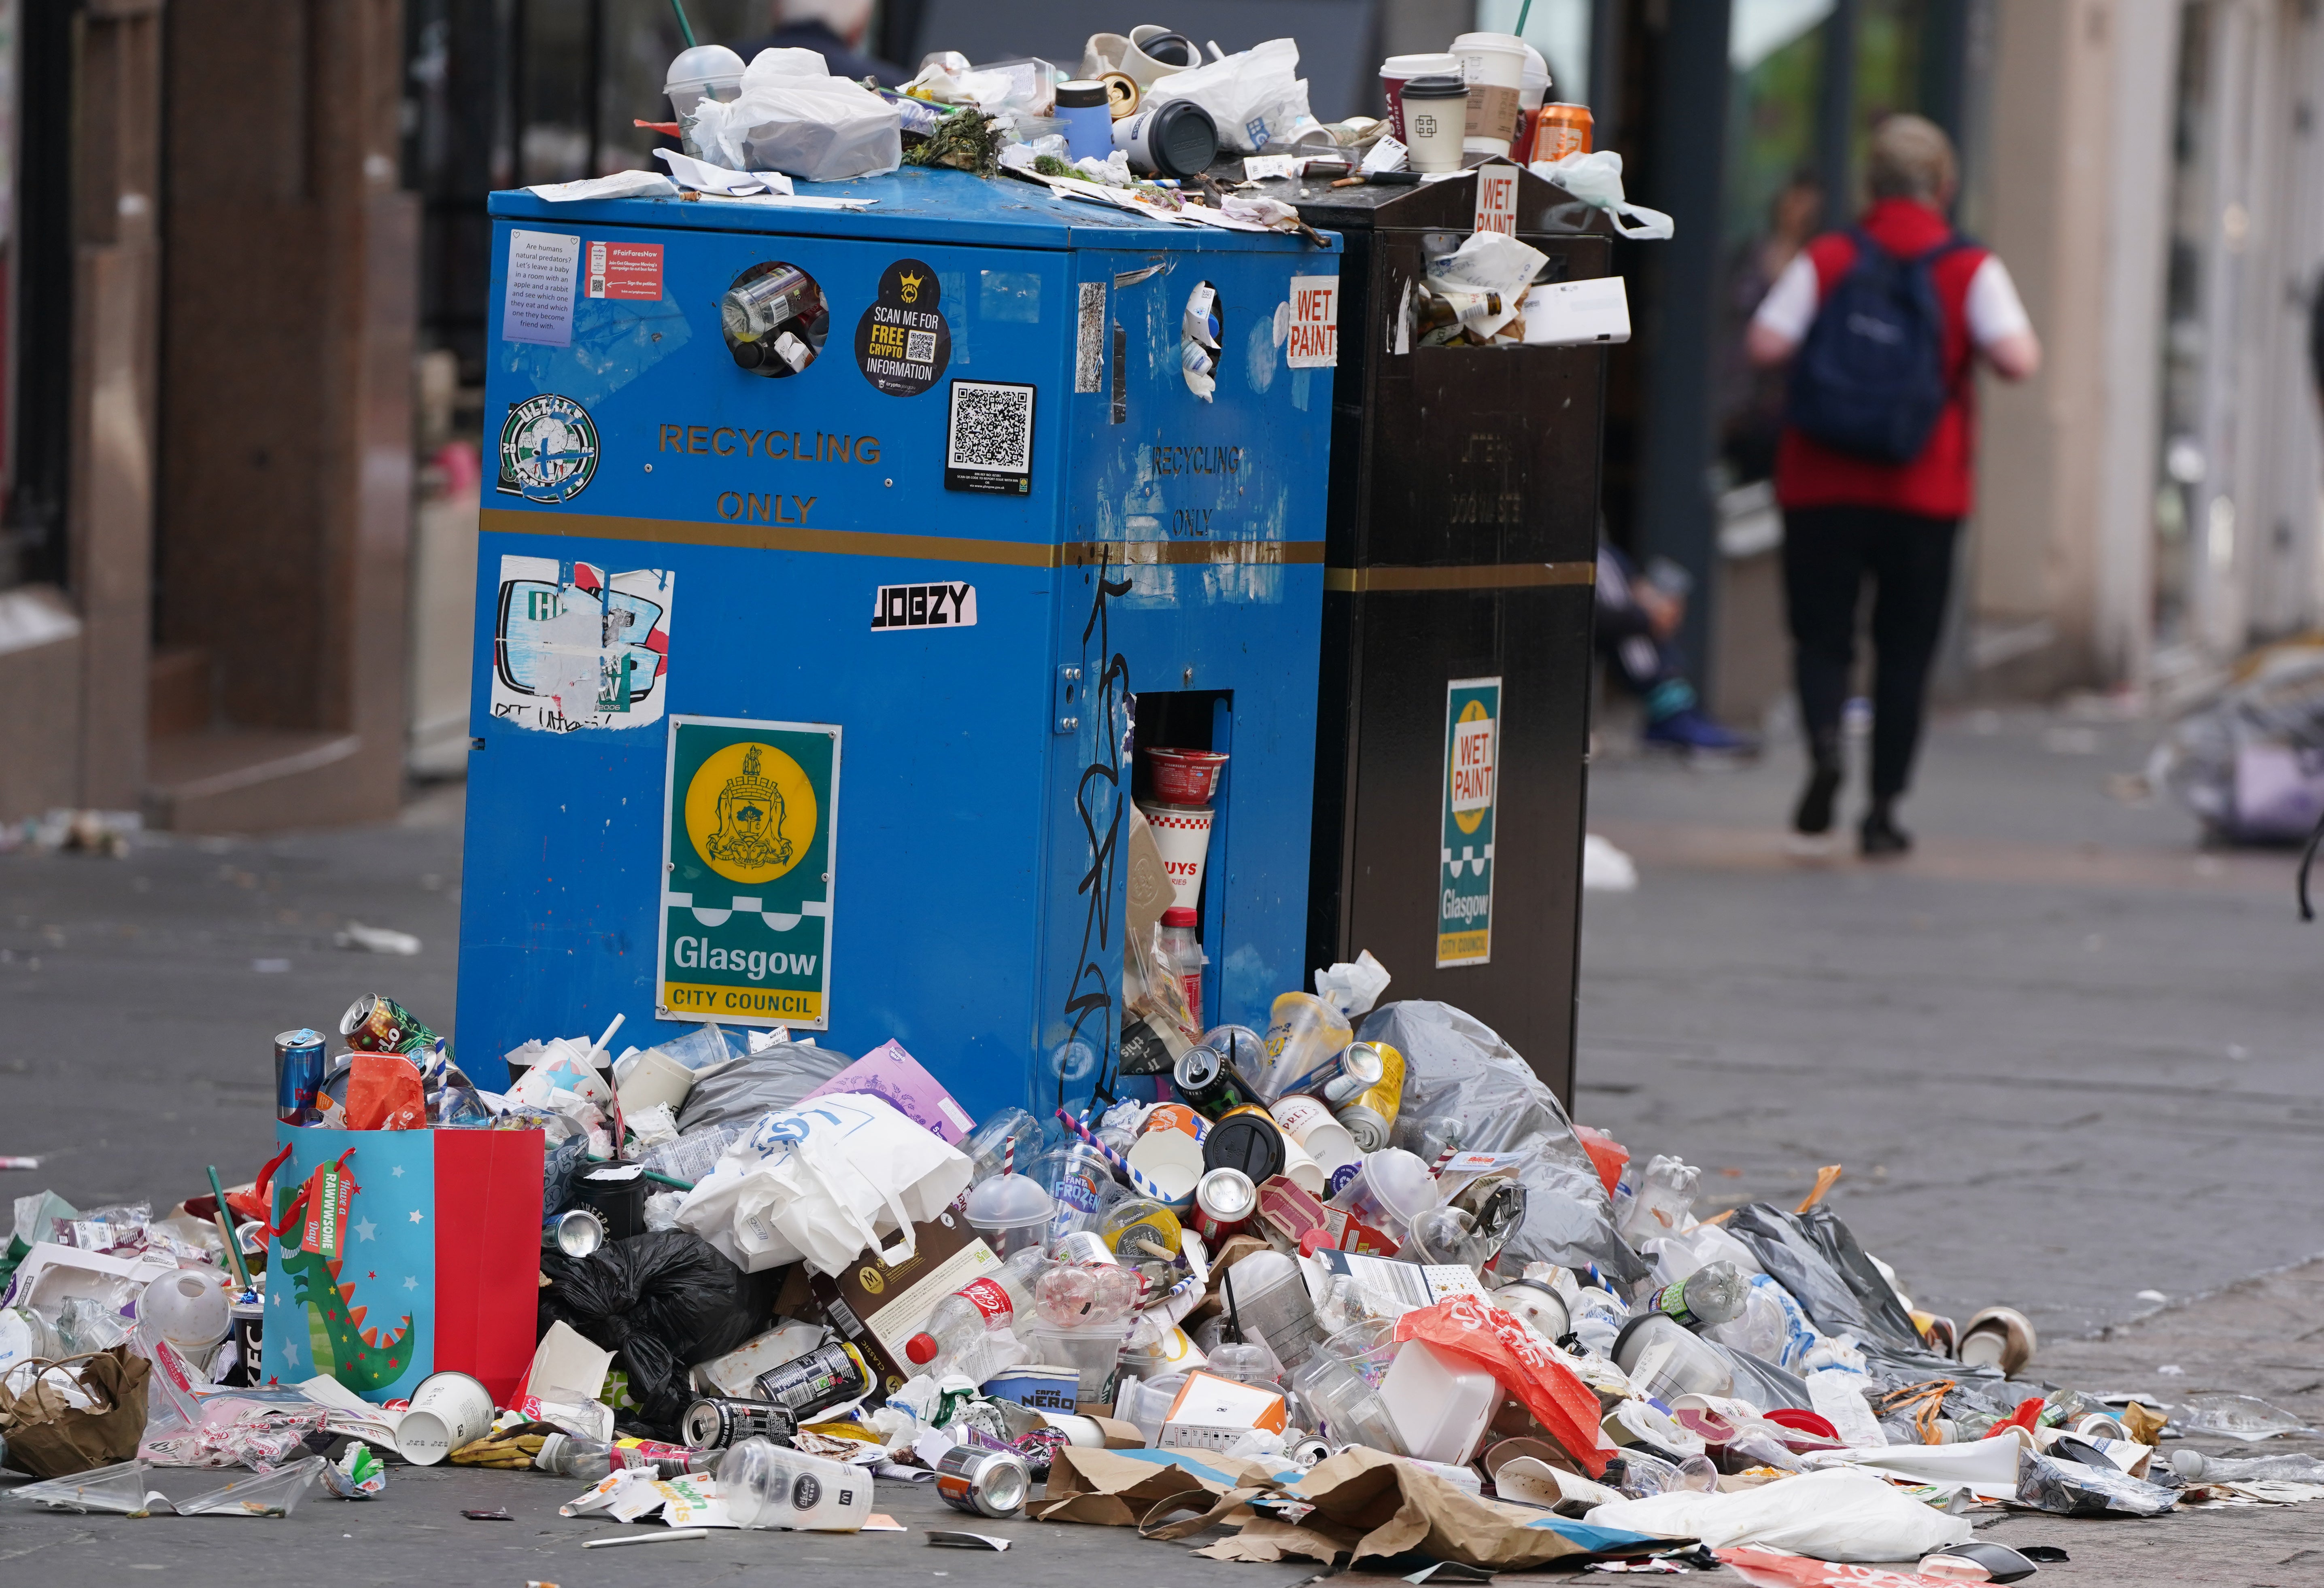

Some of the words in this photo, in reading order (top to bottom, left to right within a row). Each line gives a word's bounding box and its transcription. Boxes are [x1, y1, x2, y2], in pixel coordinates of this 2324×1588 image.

[1484, 178, 1512, 210] WET
[1477, 213, 1515, 234] PAINT
[538, 244, 563, 253] humans
[539, 255, 571, 263] predators?
[613, 249, 657, 258] #FairFaresNow
[554, 265, 569, 274] baby
[1298, 289, 1332, 322] WET
[520, 320, 538, 328] friend
[540, 313, 565, 321] become
[874, 306, 901, 324] SCAN
[903, 310, 918, 327] ME
[919, 313, 939, 330] FOR
[871, 324, 905, 346] FREE
[1289, 325, 1336, 357] PAINT
[869, 342, 903, 359] CRYPTO
[866, 357, 933, 381] INFORMATION
[502, 442, 516, 454] 20
[659, 423, 881, 465] RECYCLING
[1152, 446, 1240, 476] RECYCLING
[716, 490, 818, 524] ONLY
[1173, 508, 1213, 537] ONLY
[1460, 732, 1489, 766] WET
[1454, 766, 1492, 802] PAINT
[1164, 862, 1197, 876] UYS
[1442, 888, 1489, 925] Glasgow
[1441, 934, 1458, 956] CITY
[1458, 933, 1486, 954] COUNCIL
[673, 936, 817, 980] Glasgow
[672, 989, 716, 1008] CITY
[725, 992, 812, 1014] COUNCIL
[770, 1028, 787, 1039] RETURN
[890, 1046, 906, 1061] Brunch
[890, 1051, 900, 1060] Bar
[1121, 1036, 1145, 1057] this
[1283, 1108, 1309, 1130] PRET
[338, 1178, 351, 1205] Have
[1064, 1174, 1088, 1187] FANTA
[1054, 1180, 1102, 1214] FROZEN
[322, 1172, 337, 1250] RAWWWSOME
[338, 1207, 346, 1216] a
[1123, 1210, 1145, 1223] mooboo
[306, 1219, 319, 1248] Day!
[987, 1285, 999, 1298] TASTE
[247, 1326, 263, 1388] KFC
[861, 1340, 885, 1371] CLASSIC
[1021, 1395, 1075, 1410] NERO
[247, 1438, 279, 1455] Hostess
